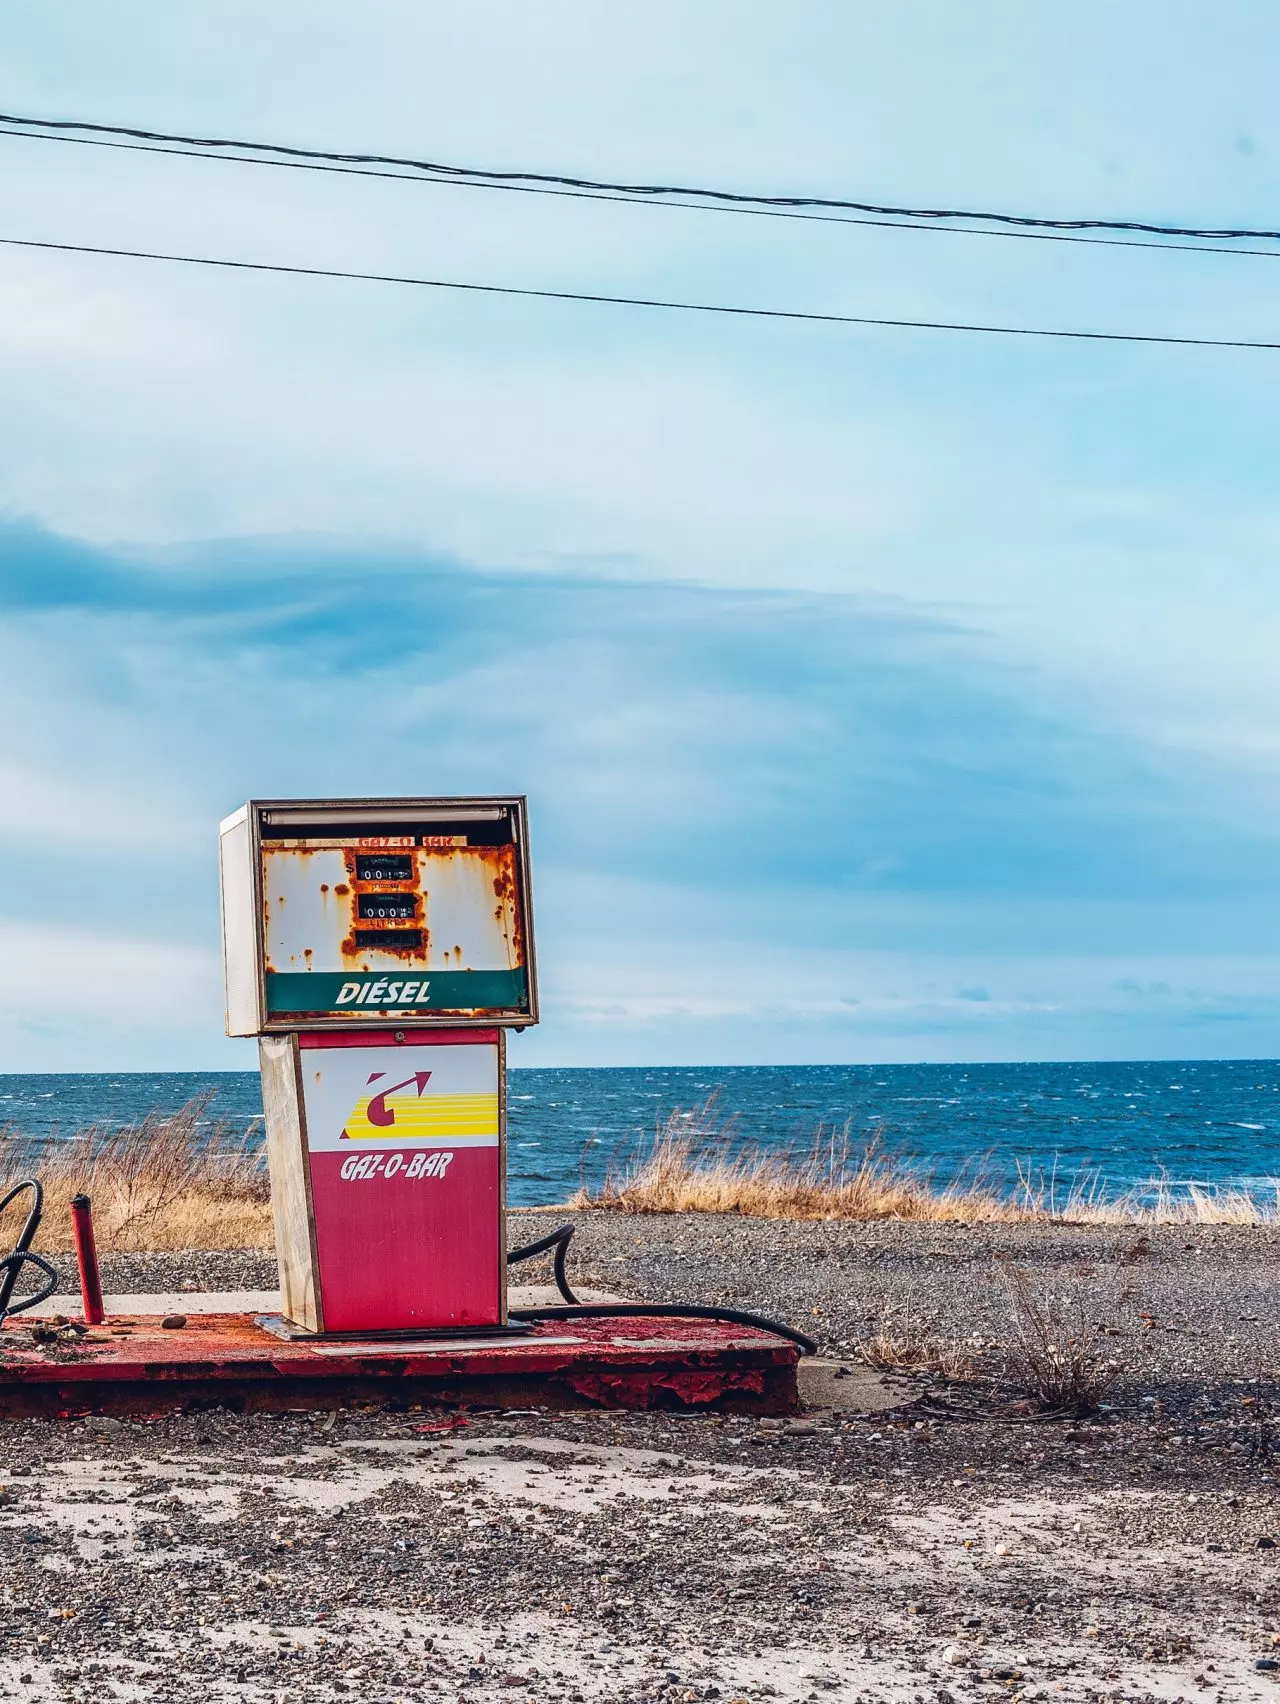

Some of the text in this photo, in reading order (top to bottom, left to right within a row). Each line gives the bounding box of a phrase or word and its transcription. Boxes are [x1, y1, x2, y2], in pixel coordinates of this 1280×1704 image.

[346, 863, 354, 876] $
[335, 977, 430, 1005] DIÉSEL
[340, 1152, 454, 1182] GAZ-O-BAR
